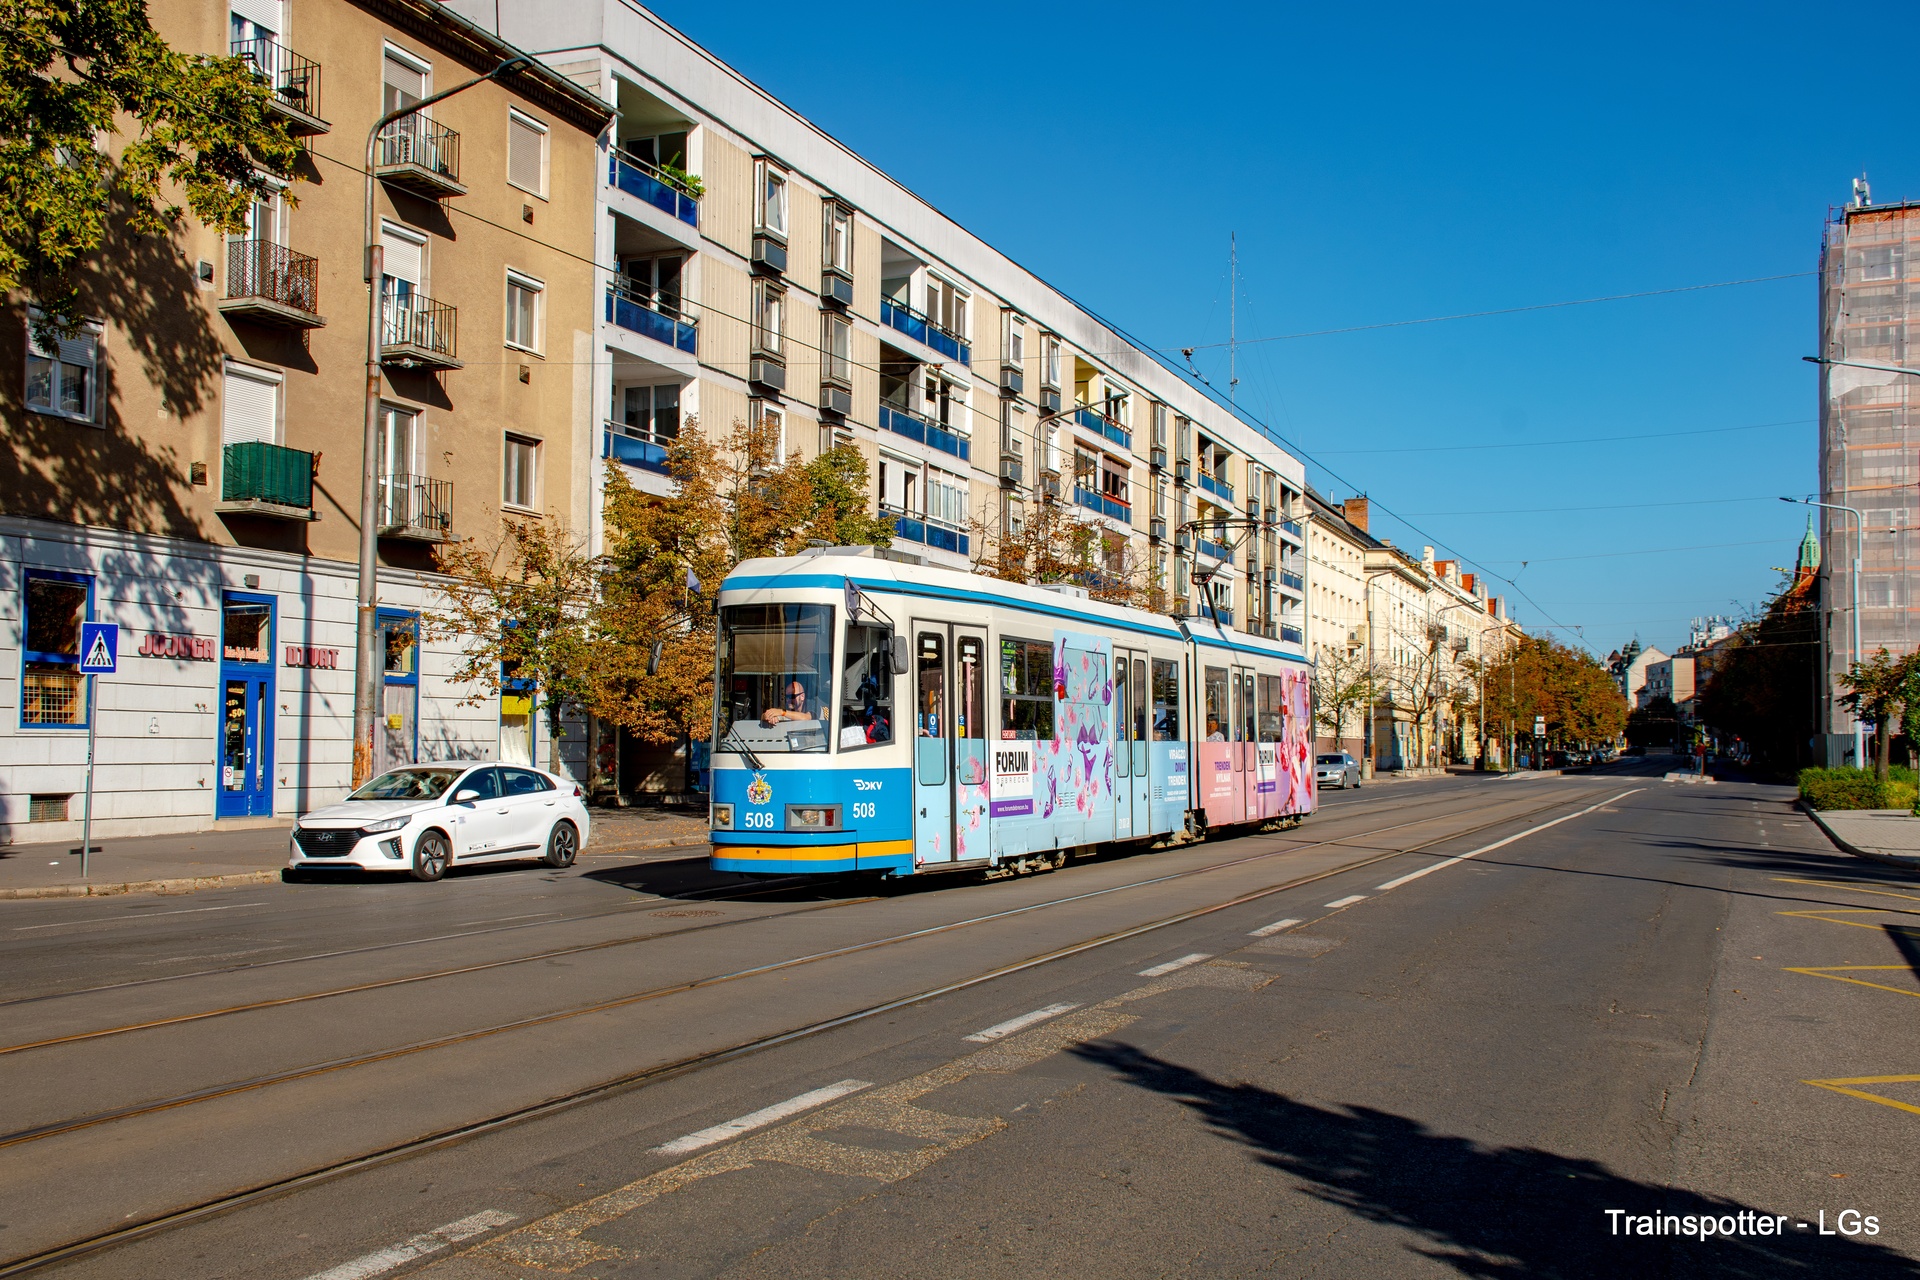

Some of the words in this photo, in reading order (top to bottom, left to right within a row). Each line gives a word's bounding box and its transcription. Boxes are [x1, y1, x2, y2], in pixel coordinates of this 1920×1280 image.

[138, 634, 216, 661] JUJUGA
[286, 646, 340, 669] DIVAT
[996, 751, 1028, 773] FORUM
[1175, 762, 1186, 772] DIVAT
[1167, 775, 1186, 787] TRENDEK
[853, 803, 875, 819] 508
[745, 813, 774, 828] 508
